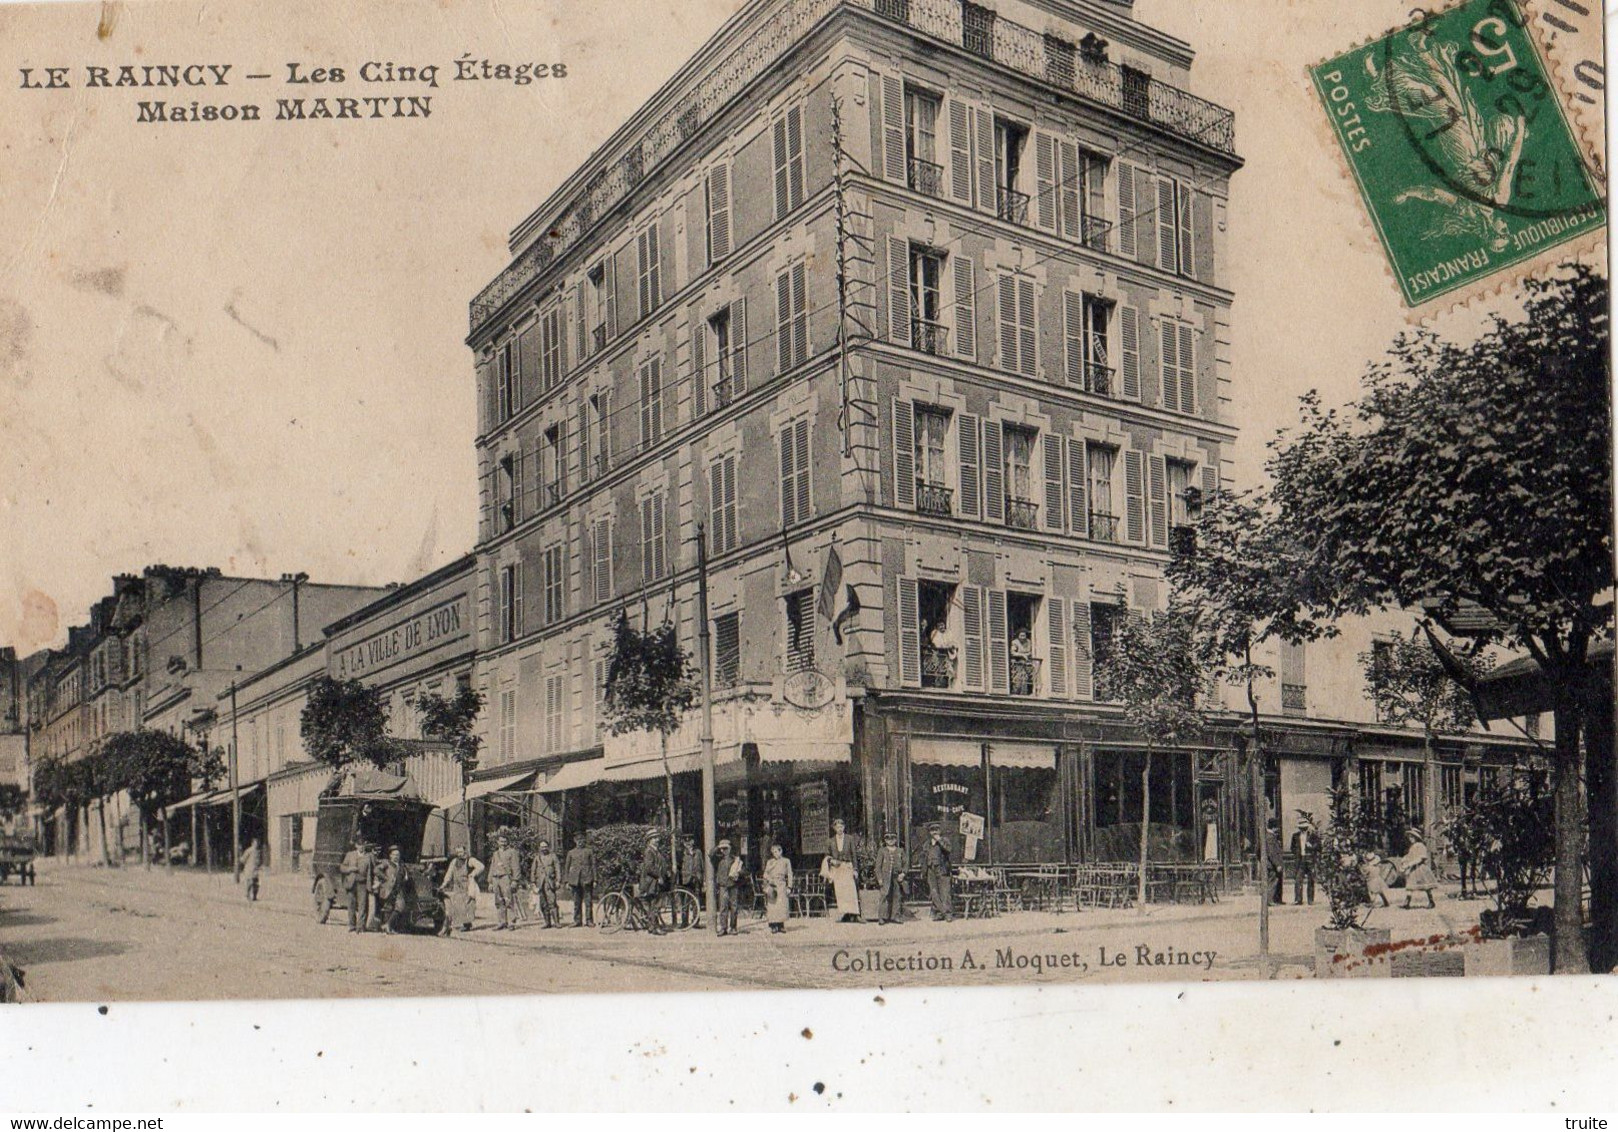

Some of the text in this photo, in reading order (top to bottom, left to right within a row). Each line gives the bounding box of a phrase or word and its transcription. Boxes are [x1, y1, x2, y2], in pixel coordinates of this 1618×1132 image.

[1468, 17, 1518, 78] 5
[1323, 71, 1372, 153] POSTES
[1408, 246, 1490, 295] FRANÇAISE
[339, 602, 462, 679] A LA VILLE DE LYON
